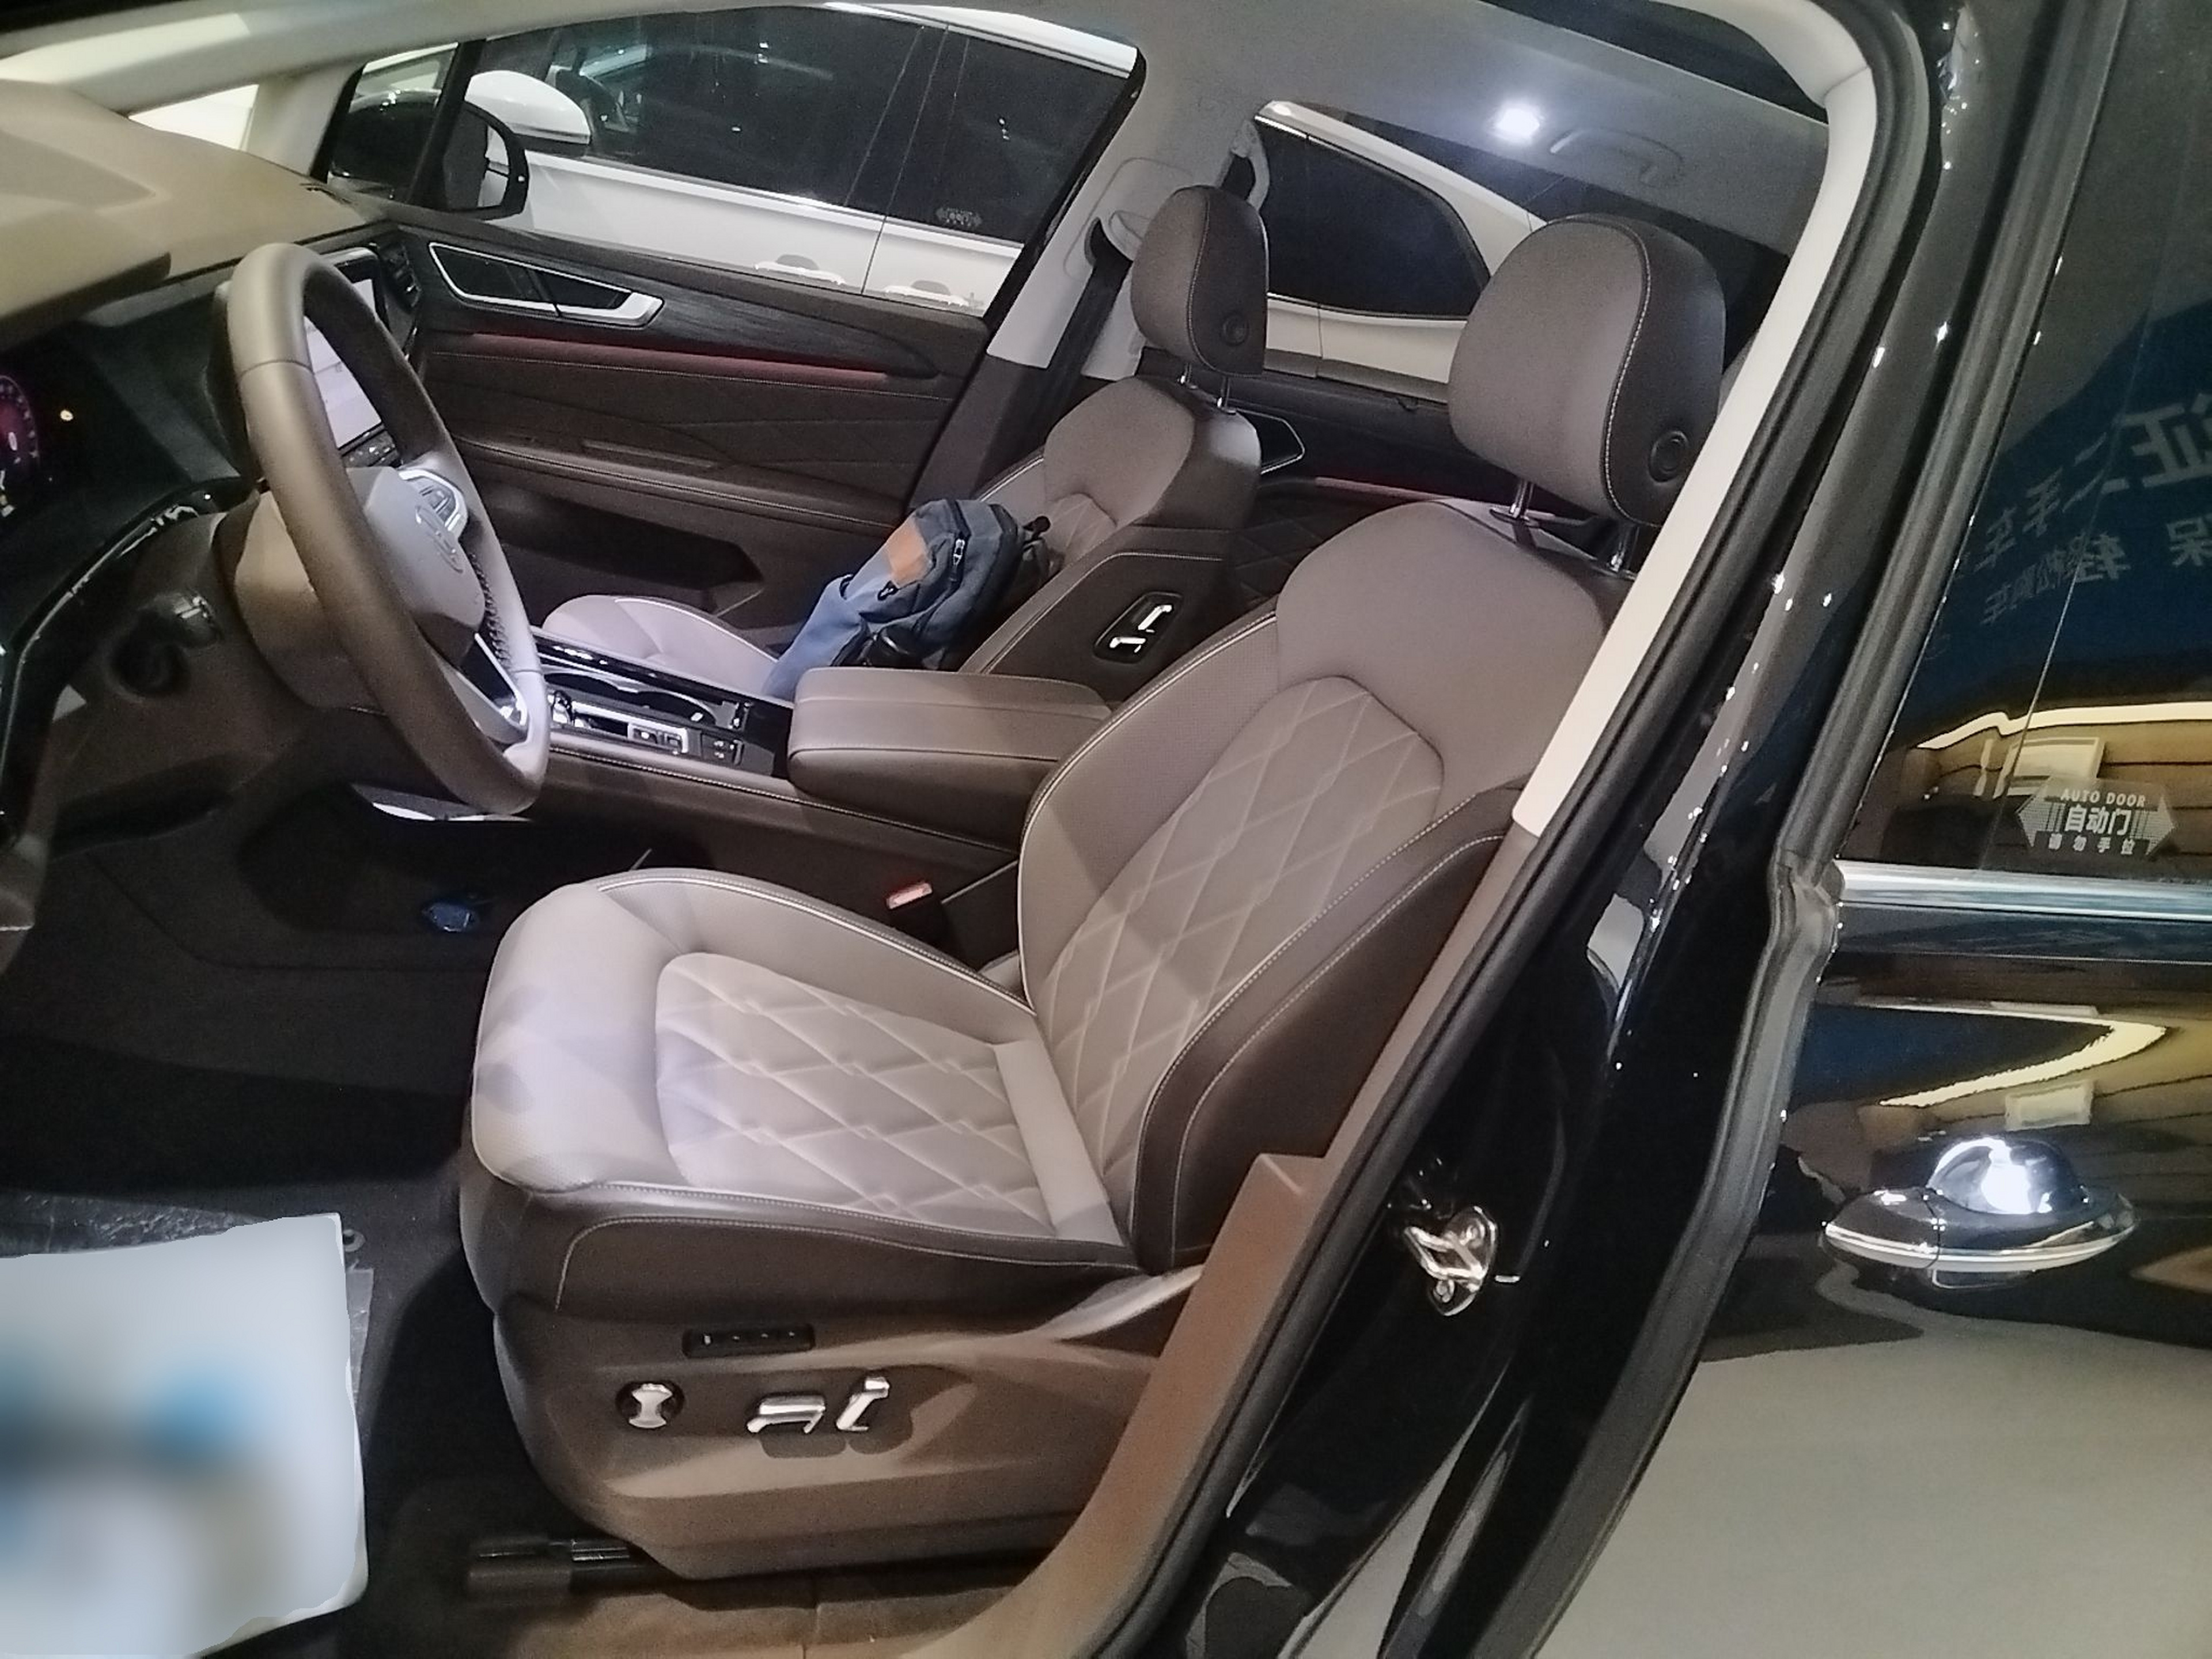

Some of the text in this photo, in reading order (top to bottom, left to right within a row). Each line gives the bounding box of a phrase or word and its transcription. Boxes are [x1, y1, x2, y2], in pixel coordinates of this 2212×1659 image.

[2061, 789, 2146, 806] AUTO DOOR
[2065, 804, 2132, 835] 自动门
